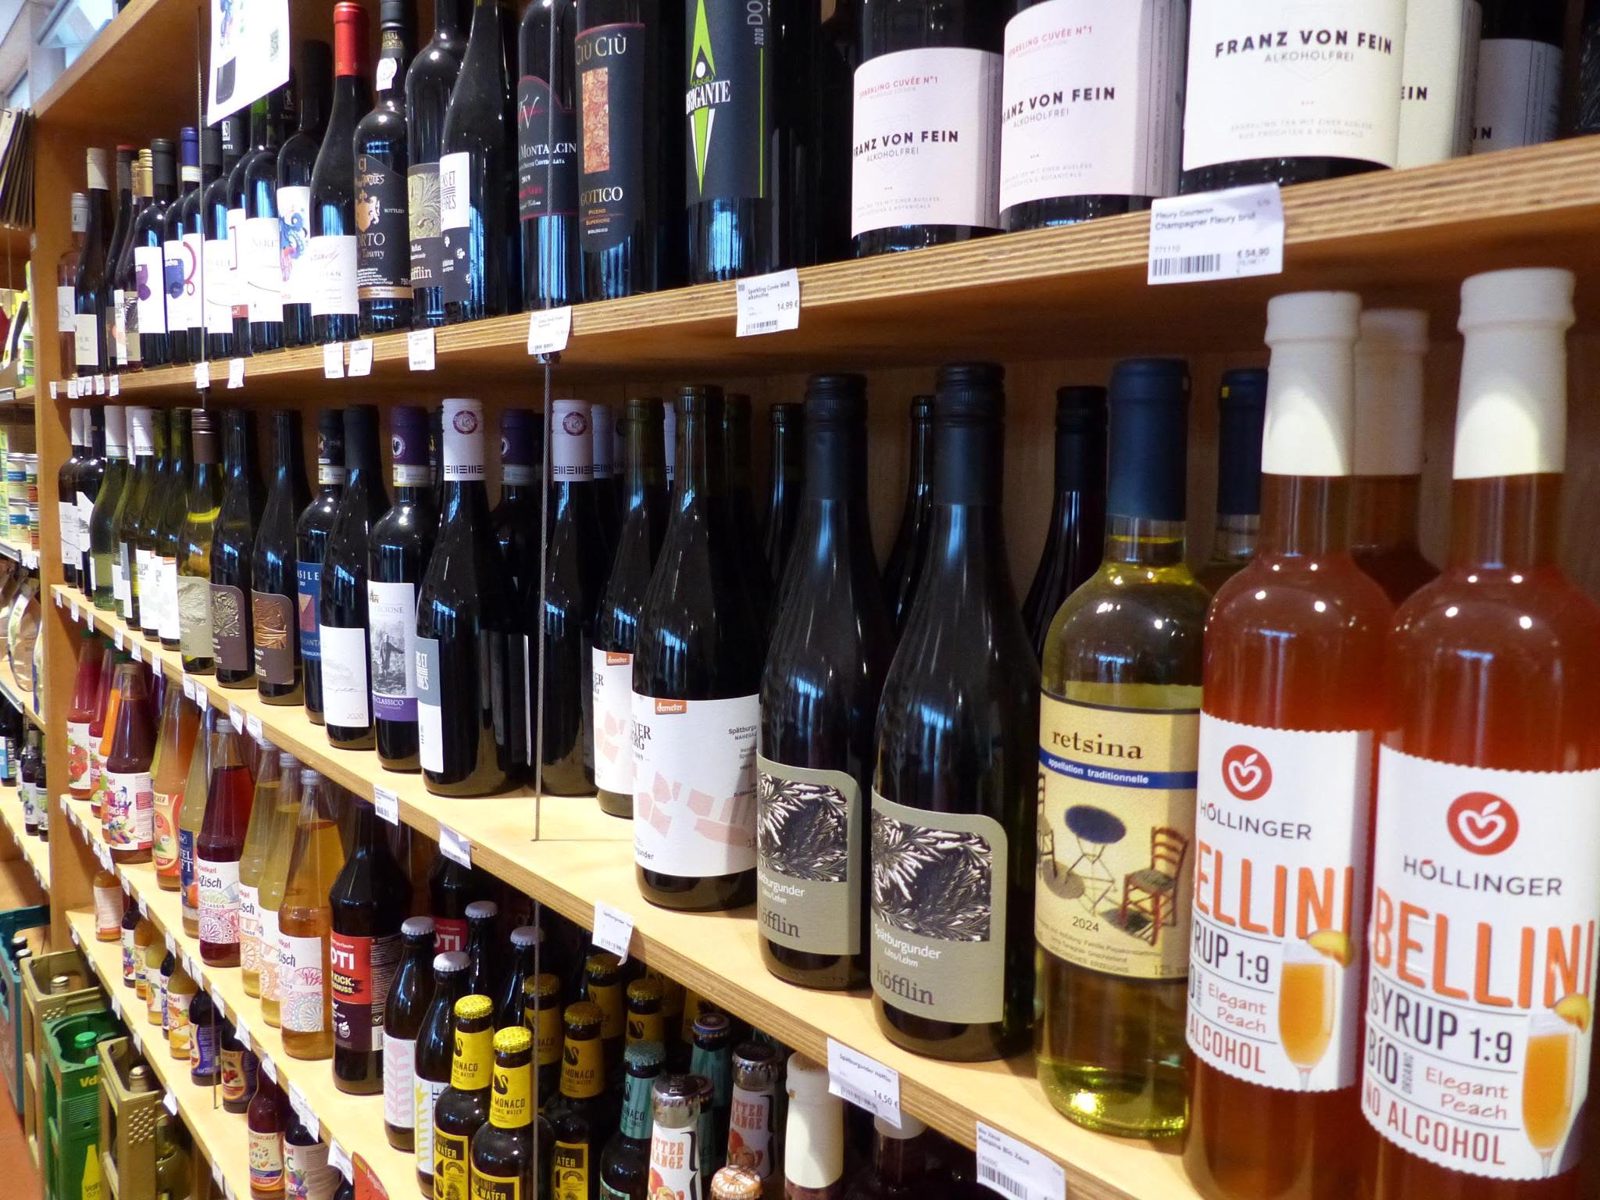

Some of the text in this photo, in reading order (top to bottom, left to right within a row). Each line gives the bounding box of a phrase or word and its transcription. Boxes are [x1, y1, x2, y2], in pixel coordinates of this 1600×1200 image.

[594, 33, 627, 57] CIÙ
[1215, 29, 1392, 58] FRANZ VON FEIN
[1264, 50, 1355, 63] ALKOHOLFREI
[893, 77, 921, 87] CUVÉE
[1401, 86, 1428, 101] EIN
[1029, 91, 1063, 110] VON
[1072, 87, 1116, 102] FEIN
[1013, 107, 1070, 128] ALKOHOLFREI
[882, 132, 913, 148] VON
[921, 130, 959, 143] FEIN
[866, 146, 920, 162] ALKOHOLFREI
[581, 185, 624, 206] GOTICO
[1154, 219, 1208, 231] Champagner
[1210, 215, 1236, 225] Fleury
[656, 702, 683, 712] demeter
[1051, 728, 1144, 760] retsina
[1047, 757, 1150, 784] appellation traditionnelle
[1199, 801, 1313, 841] HÖLLINGER
[1194, 838, 1355, 941] ELLINI
[1402, 854, 1564, 897] HÖLLINGER
[1072, 916, 1100, 933] 2024
[874, 923, 942, 960] Spätburgunder
[1193, 918, 1270, 984] RUP 1:9
[1373, 886, 1595, 1009] BELLINI
[876, 963, 935, 1006] höfflin
[1208, 981, 1267, 1016] Elegant
[1216, 1004, 1267, 1034] Peach
[1369, 975, 1513, 1064] SYRUP 1:9
[1189, 1014, 1267, 1075] ALCOHOL
[1426, 1066, 1509, 1100] Elegant
[494, 1098, 526, 1109] MONACO
[1441, 1093, 1508, 1121] Peach
[1387, 1100, 1507, 1166] ALCOHOL
